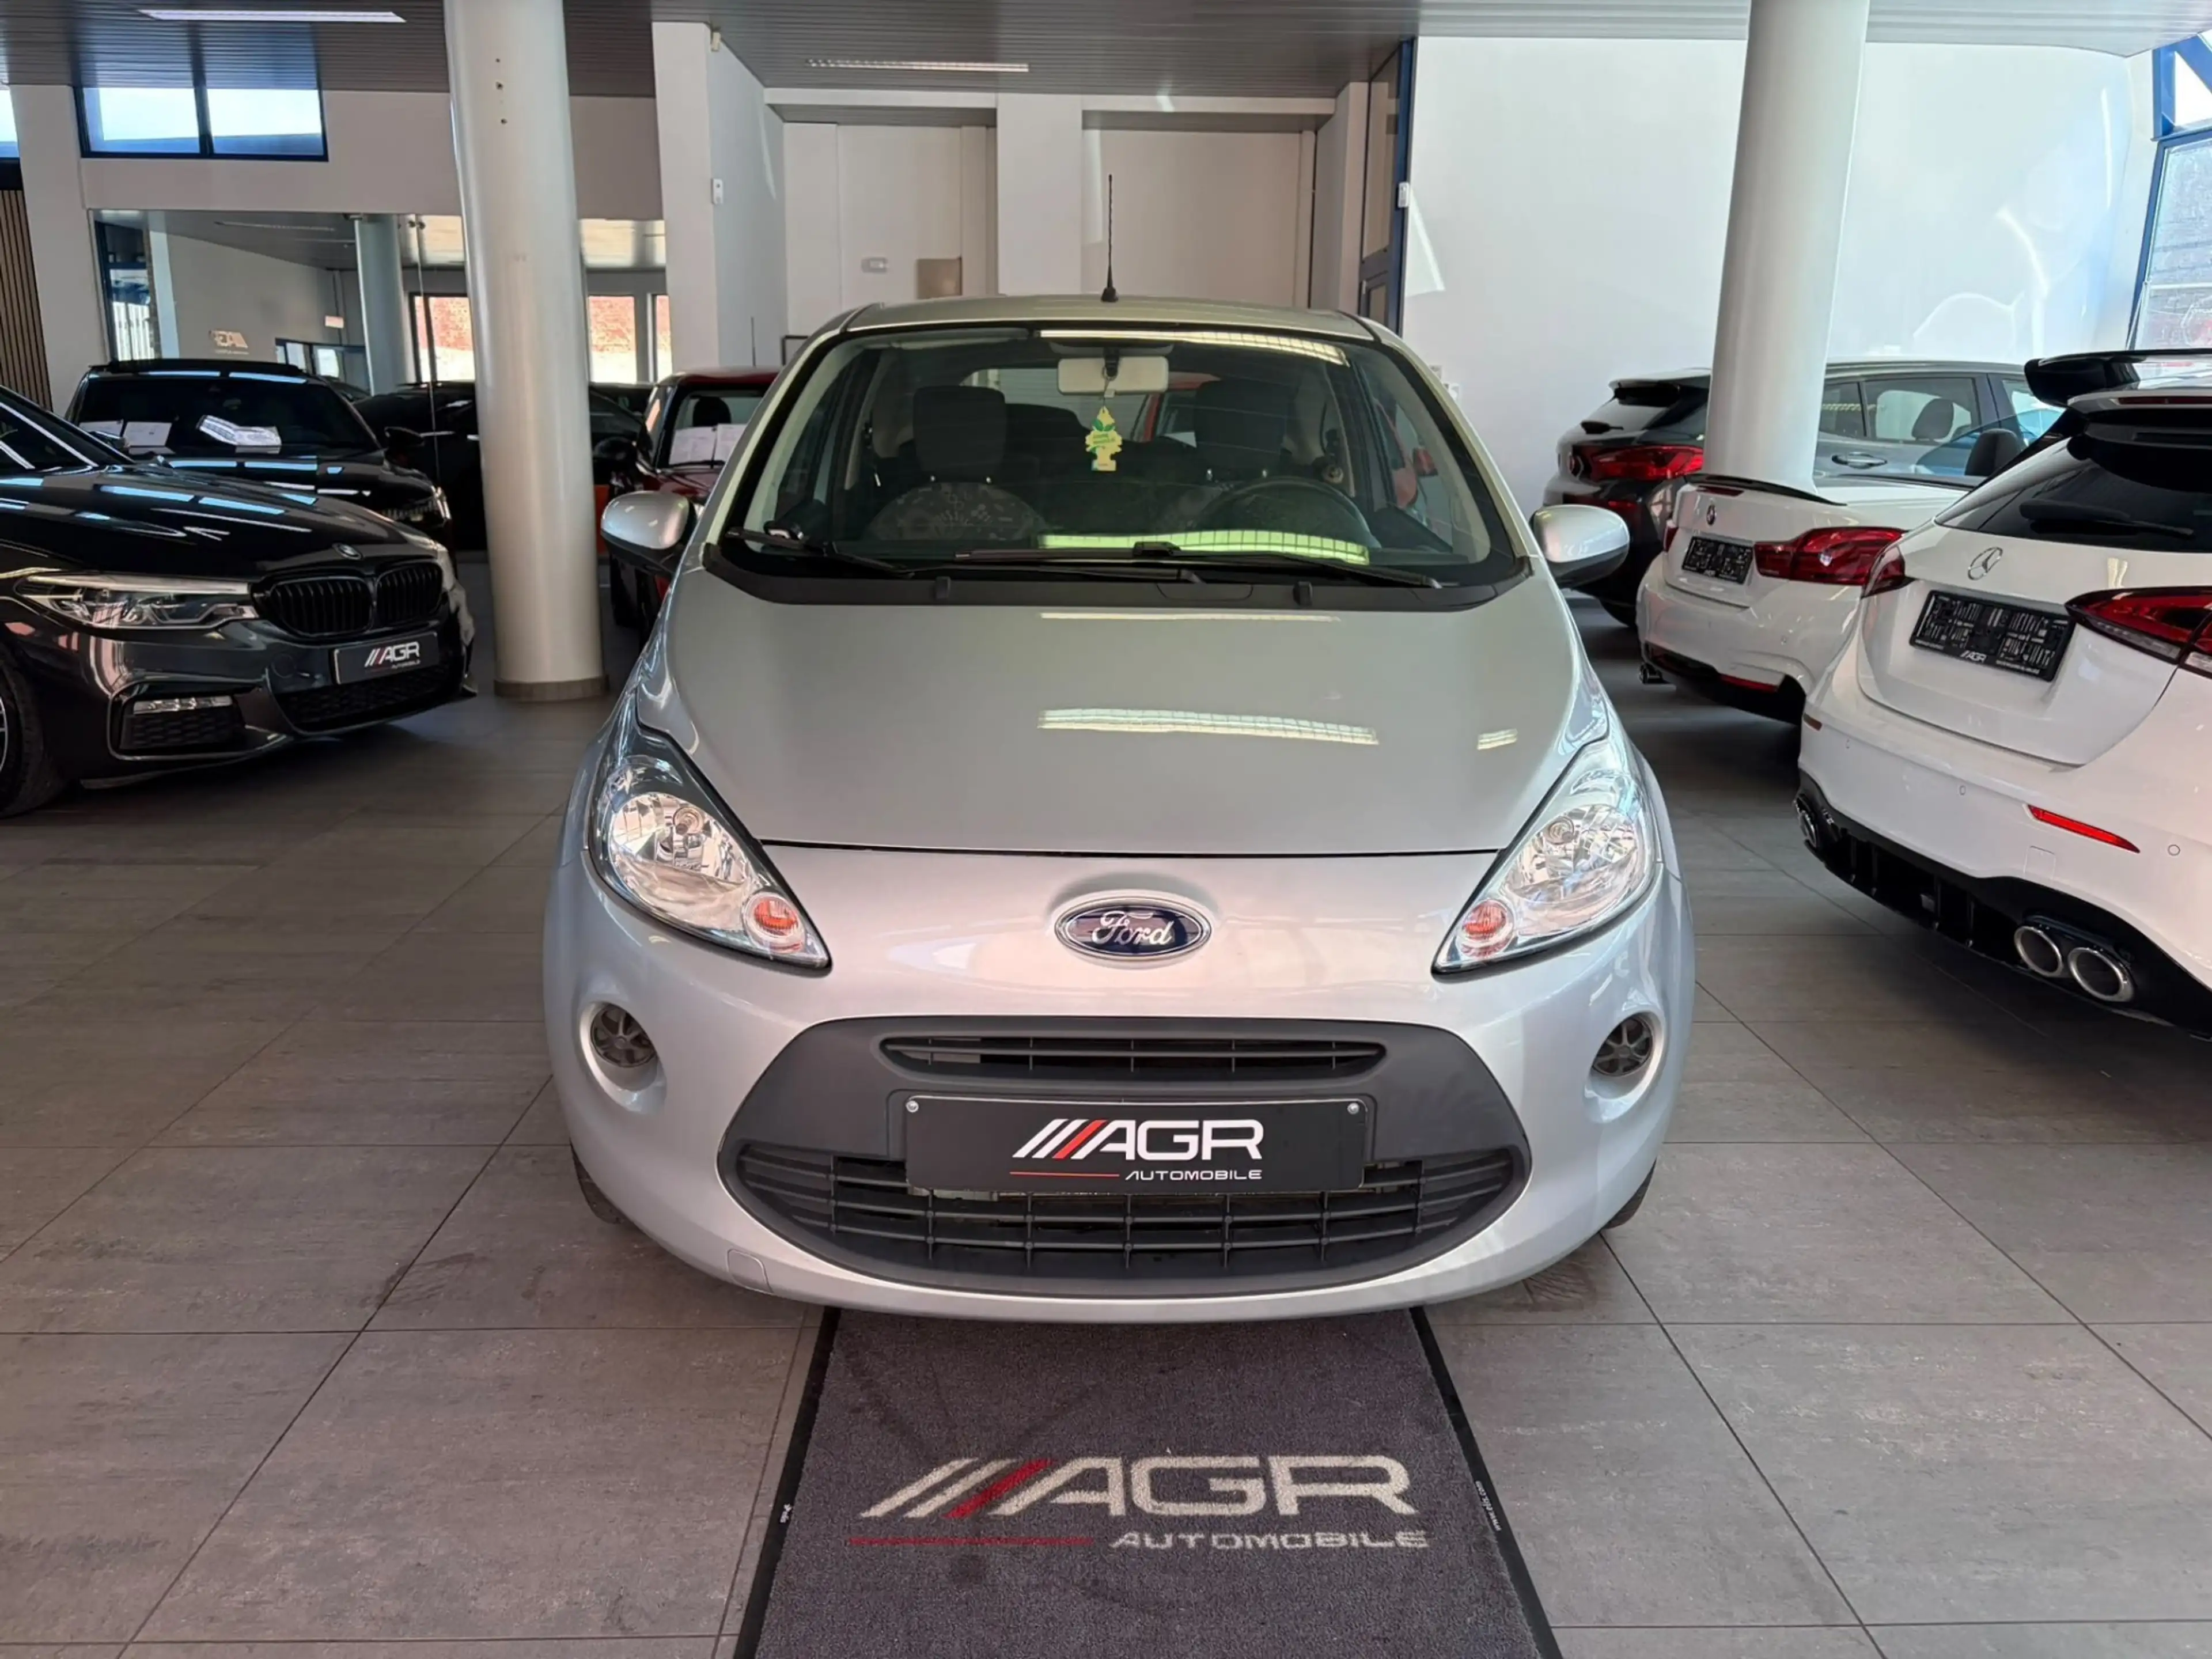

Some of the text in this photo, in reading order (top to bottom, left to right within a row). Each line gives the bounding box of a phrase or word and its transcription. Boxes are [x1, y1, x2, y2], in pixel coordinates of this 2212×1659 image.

[378, 641, 420, 665] AGR
[1092, 910, 1174, 945] Ford
[1070, 1119, 1264, 1161] AGR
[1125, 1170, 1263, 1181] AUTOMOBILE
[987, 1455, 1419, 1517] AGR
[1111, 1530, 1429, 1550] AUTOMOBILE
